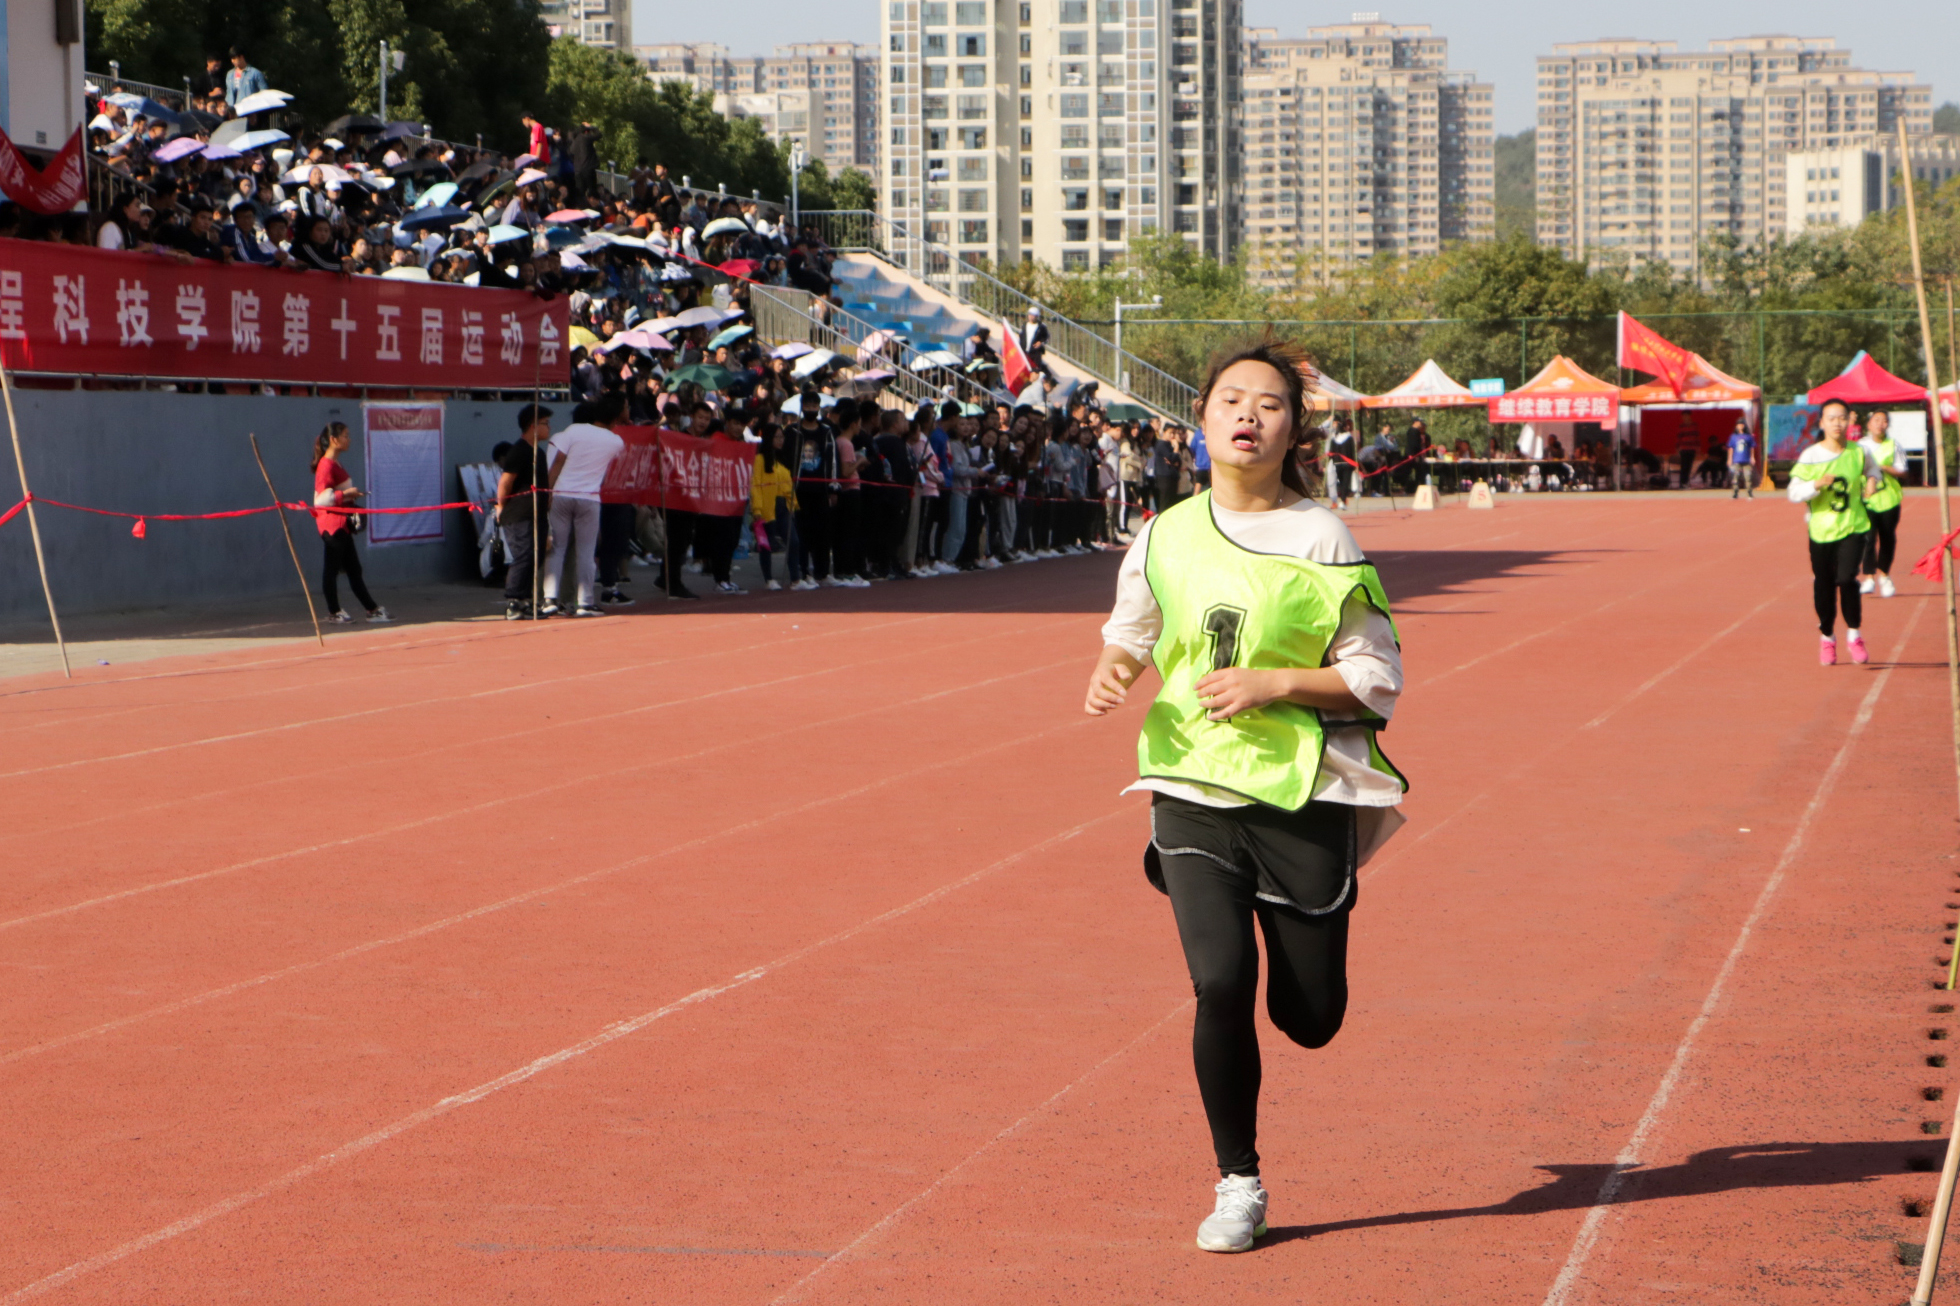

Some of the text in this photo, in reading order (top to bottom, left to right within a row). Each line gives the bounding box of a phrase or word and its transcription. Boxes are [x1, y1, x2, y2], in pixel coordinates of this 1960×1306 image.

[1497, 397, 1610, 417] 继续教育学院
[1477, 489, 1487, 501] 5
[1828, 476, 1850, 512] 3
[1201, 603, 1247, 674] 1
